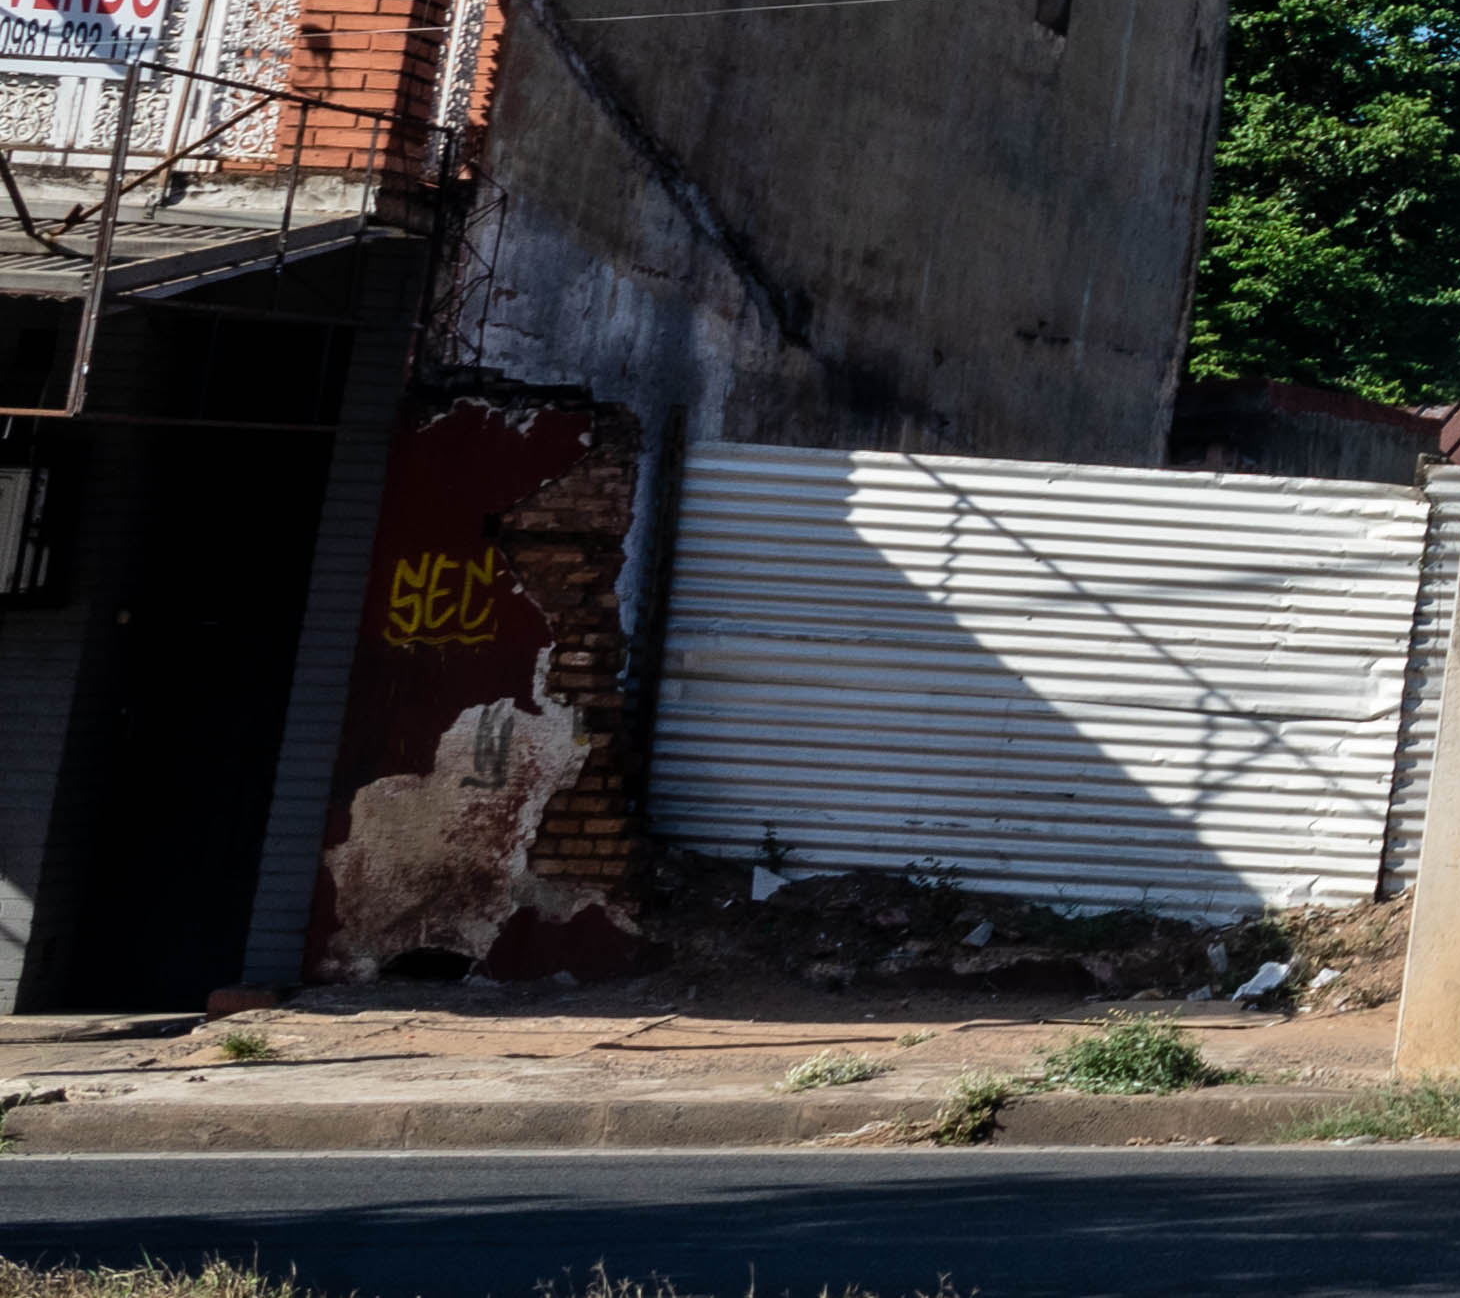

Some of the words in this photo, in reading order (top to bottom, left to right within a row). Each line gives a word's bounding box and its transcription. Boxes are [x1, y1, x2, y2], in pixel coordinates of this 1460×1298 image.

[0, 16, 52, 56] 0981
[57, 20, 103, 59] 892
[110, 24, 153, 61] 117
